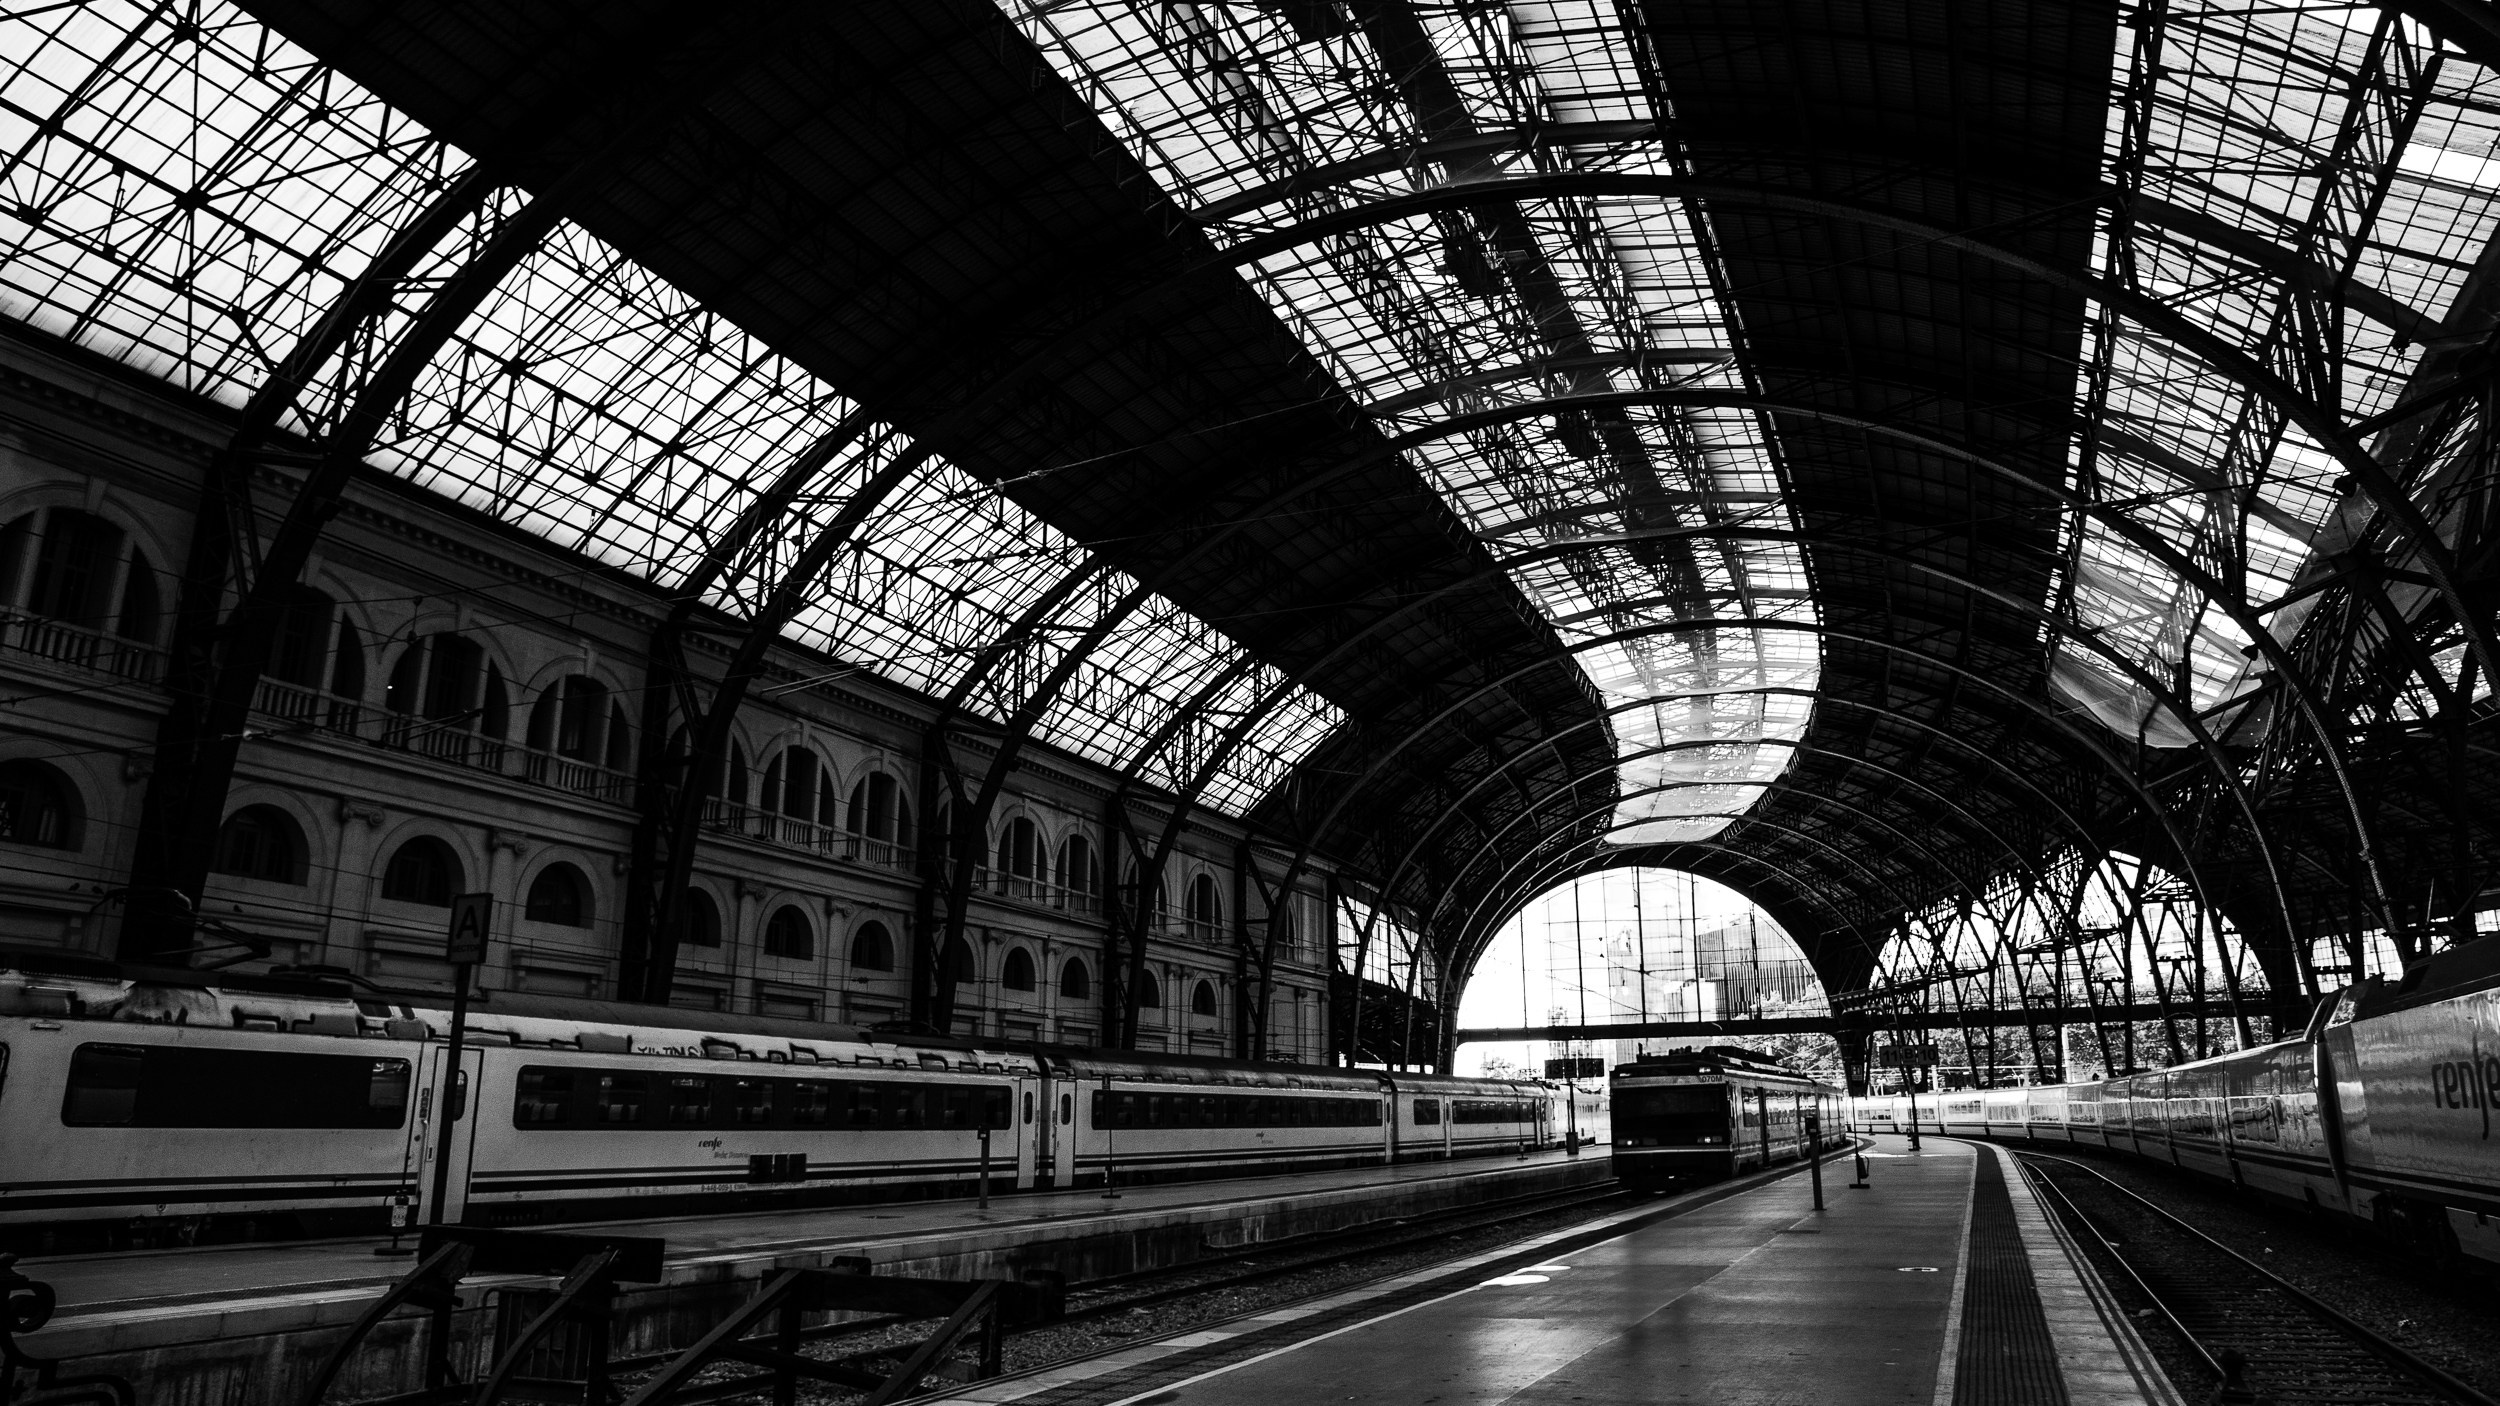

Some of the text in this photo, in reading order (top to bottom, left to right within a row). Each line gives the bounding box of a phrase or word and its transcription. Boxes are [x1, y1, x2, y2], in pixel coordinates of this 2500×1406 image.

[456, 905, 479, 939] A
[1883, 1050, 1898, 1061] 11
[1920, 1048, 1936, 1061] 10
[1546, 1063, 1561, 1075] 13
[2431, 1031, 2500, 1140] renfe
[698, 1136, 723, 1151] renfe
